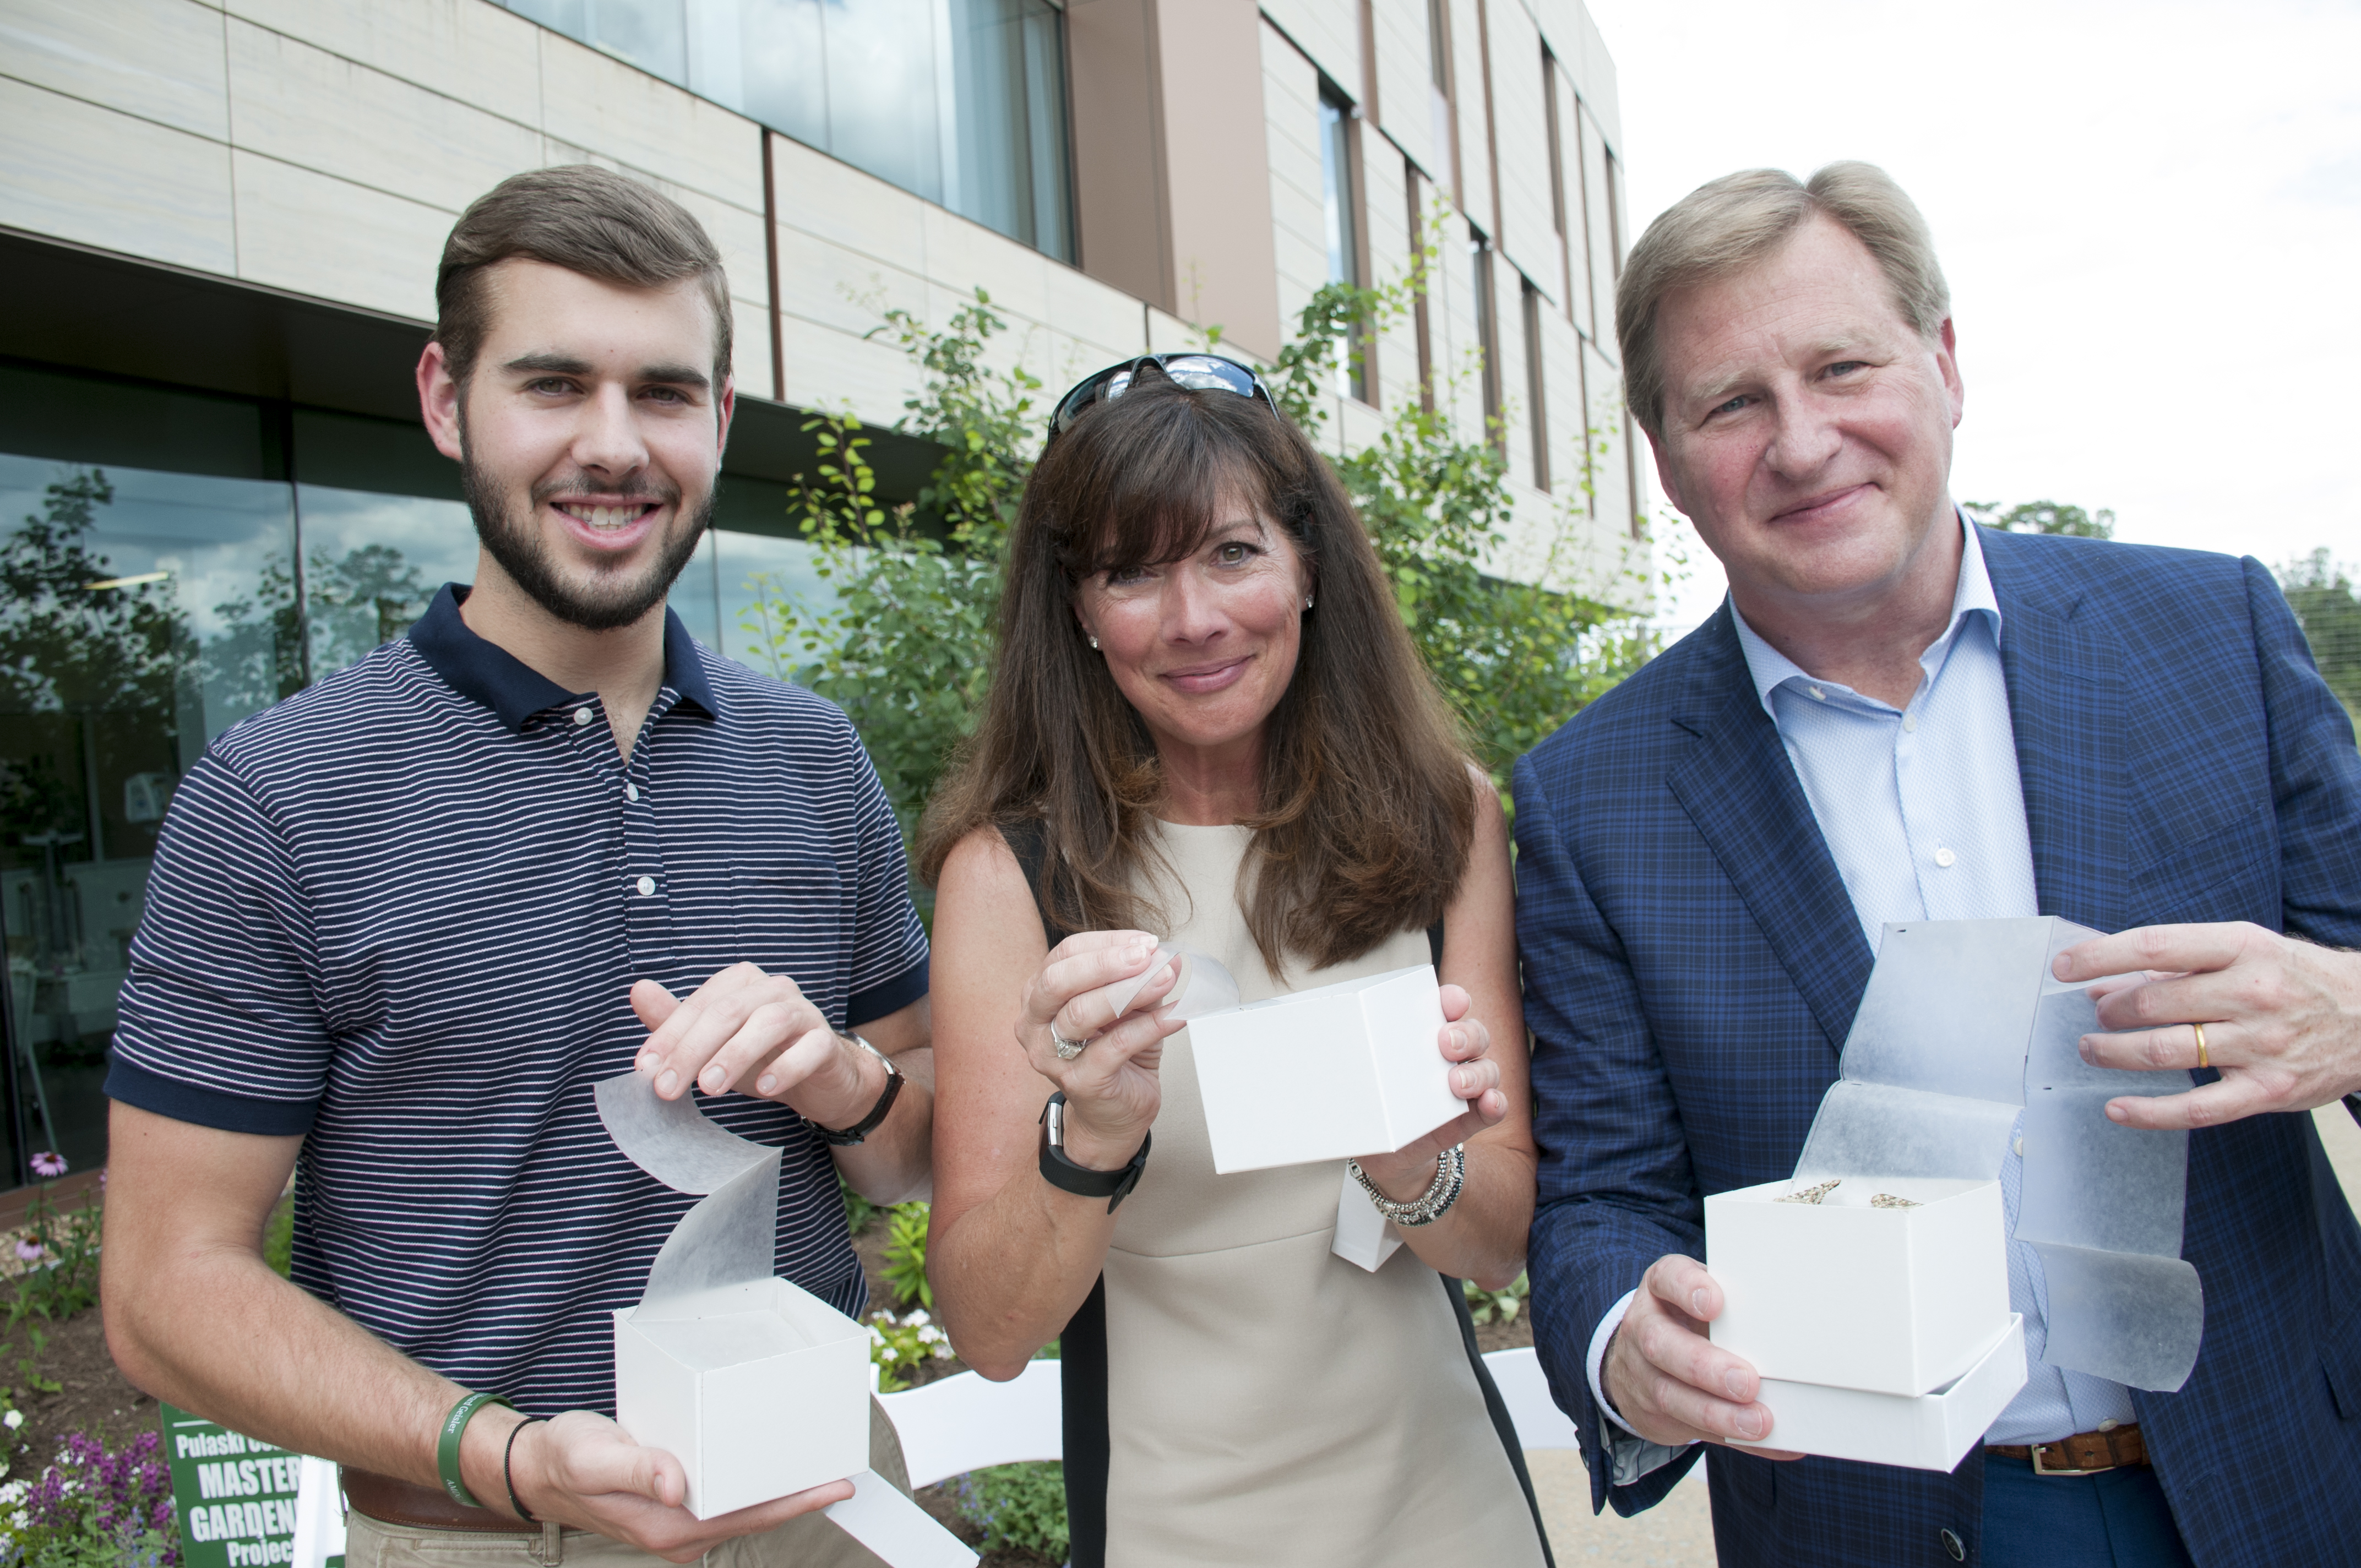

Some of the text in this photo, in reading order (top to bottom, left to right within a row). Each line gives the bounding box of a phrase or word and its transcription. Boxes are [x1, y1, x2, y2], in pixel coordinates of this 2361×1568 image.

[448, 1406, 468, 1434] Geisler
[175, 1430, 246, 1459] Pulaski
[197, 1456, 302, 1499] MASTER
[189, 1497, 298, 1542] GARDEN
[226, 1537, 295, 1567] Projec
